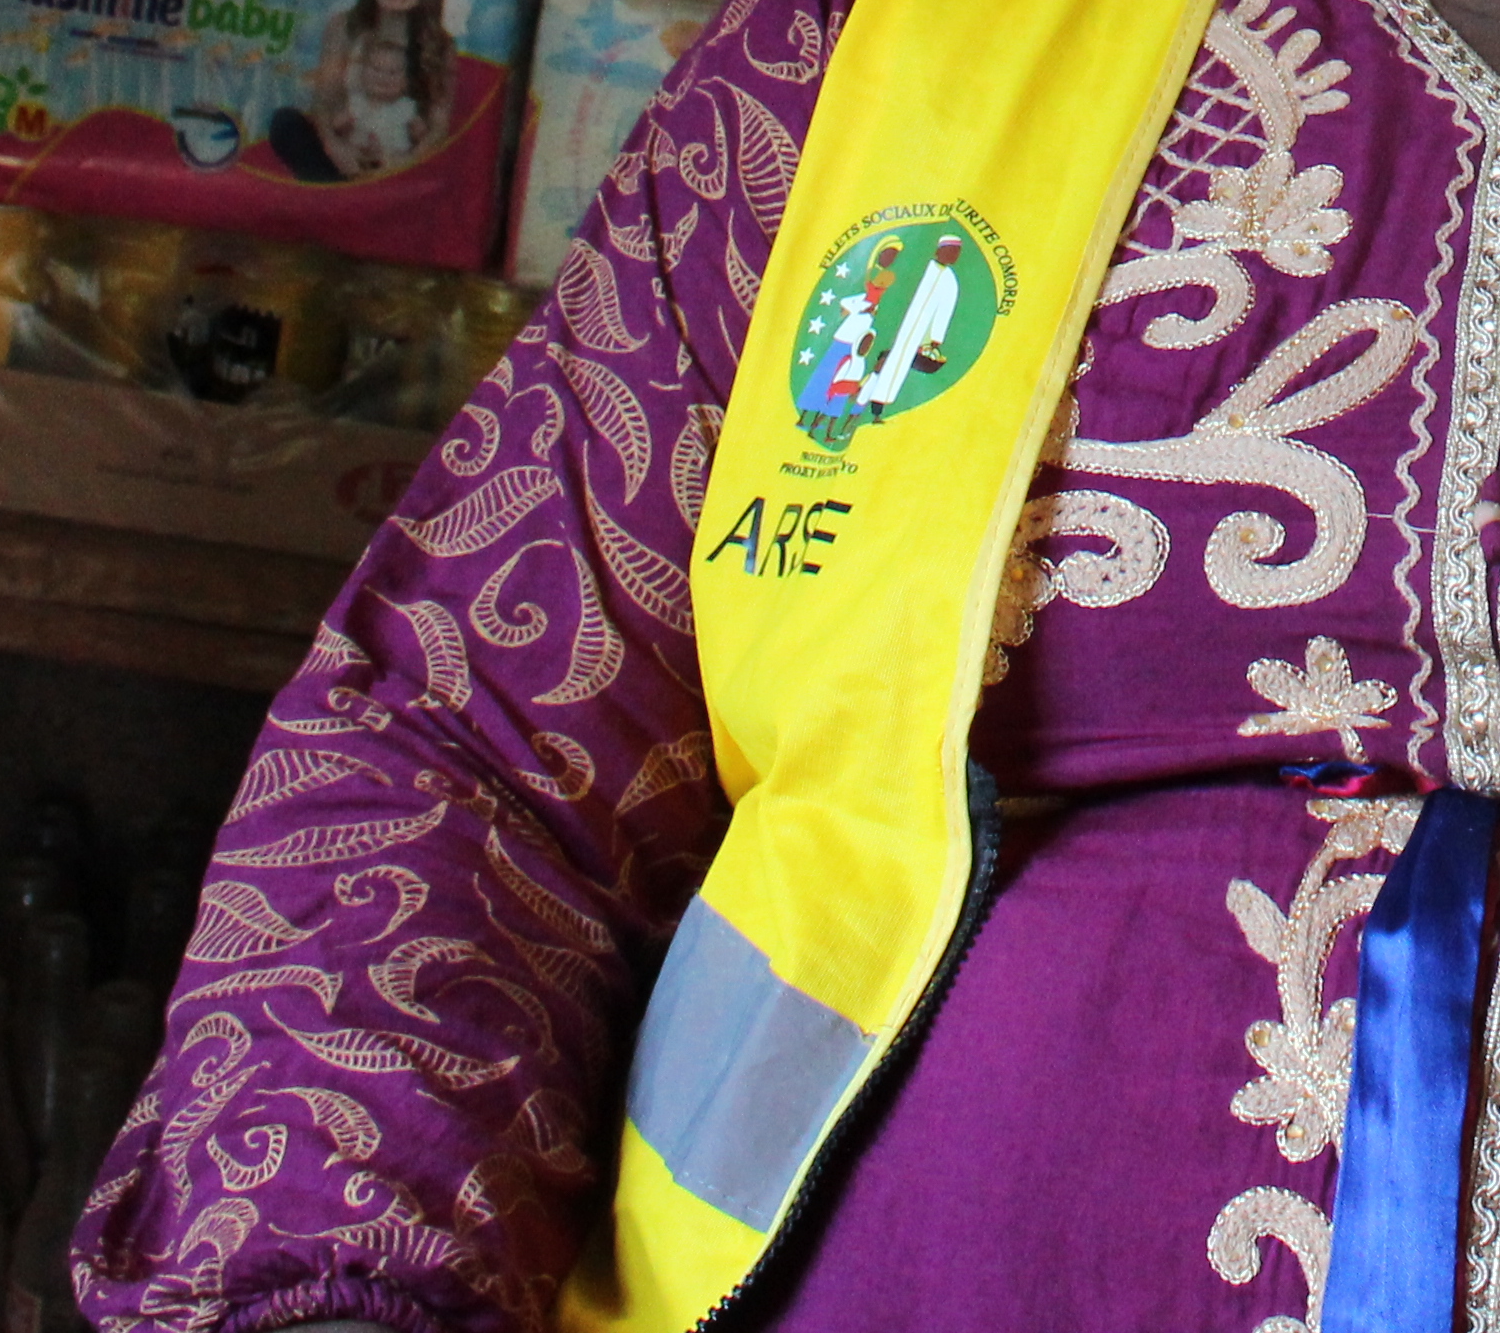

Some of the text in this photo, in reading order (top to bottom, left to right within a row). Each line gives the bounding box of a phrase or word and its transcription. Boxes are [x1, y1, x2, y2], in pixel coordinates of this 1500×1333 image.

[14, 107, 48, 134] M
[819, 220, 860, 272] FILETS
[862, 203, 935, 229] SOCIAUX
[956, 199, 1002, 248] URITE
[994, 244, 1020, 319] COMORES
